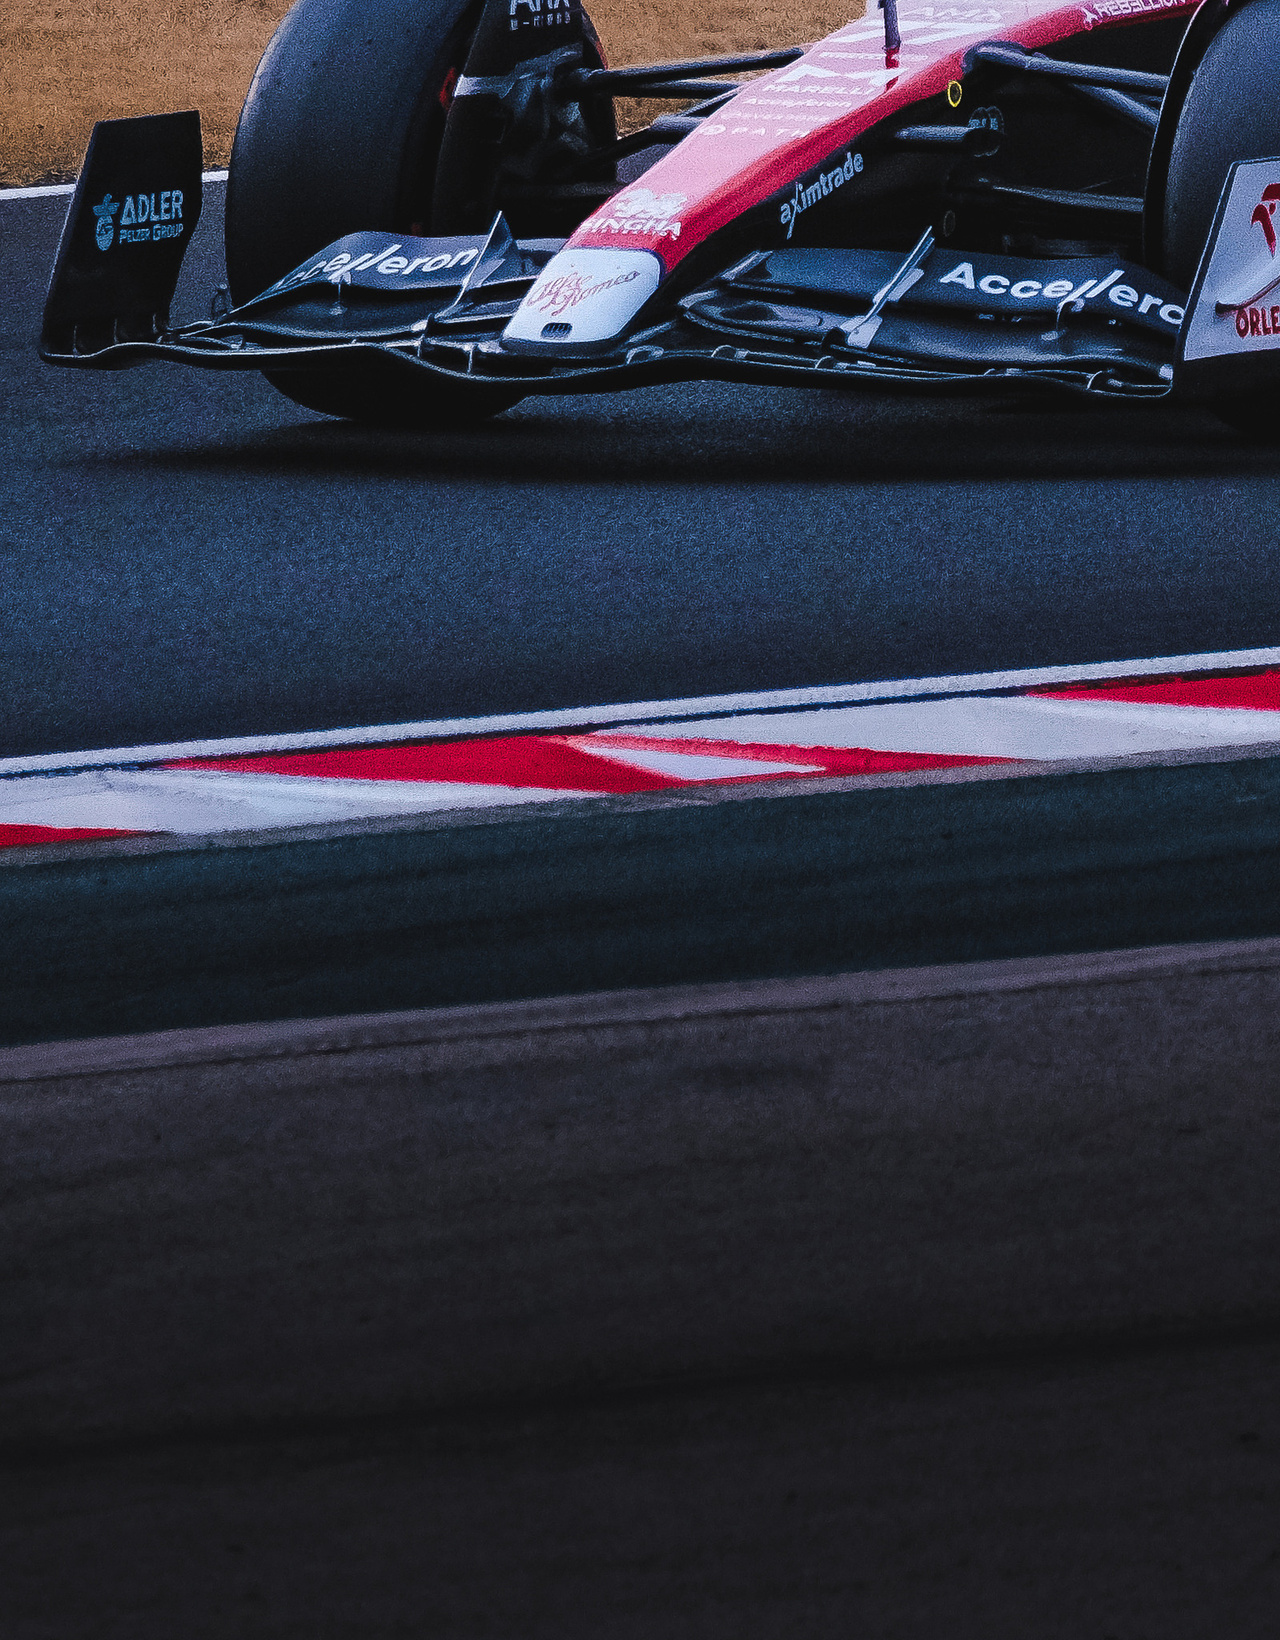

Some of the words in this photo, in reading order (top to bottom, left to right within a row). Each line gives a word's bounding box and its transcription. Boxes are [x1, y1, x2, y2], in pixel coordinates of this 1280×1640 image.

[120, 189, 184, 225] ADLER
[780, 151, 864, 240] aximtrade
[939, 262, 1186, 325] Accellero
